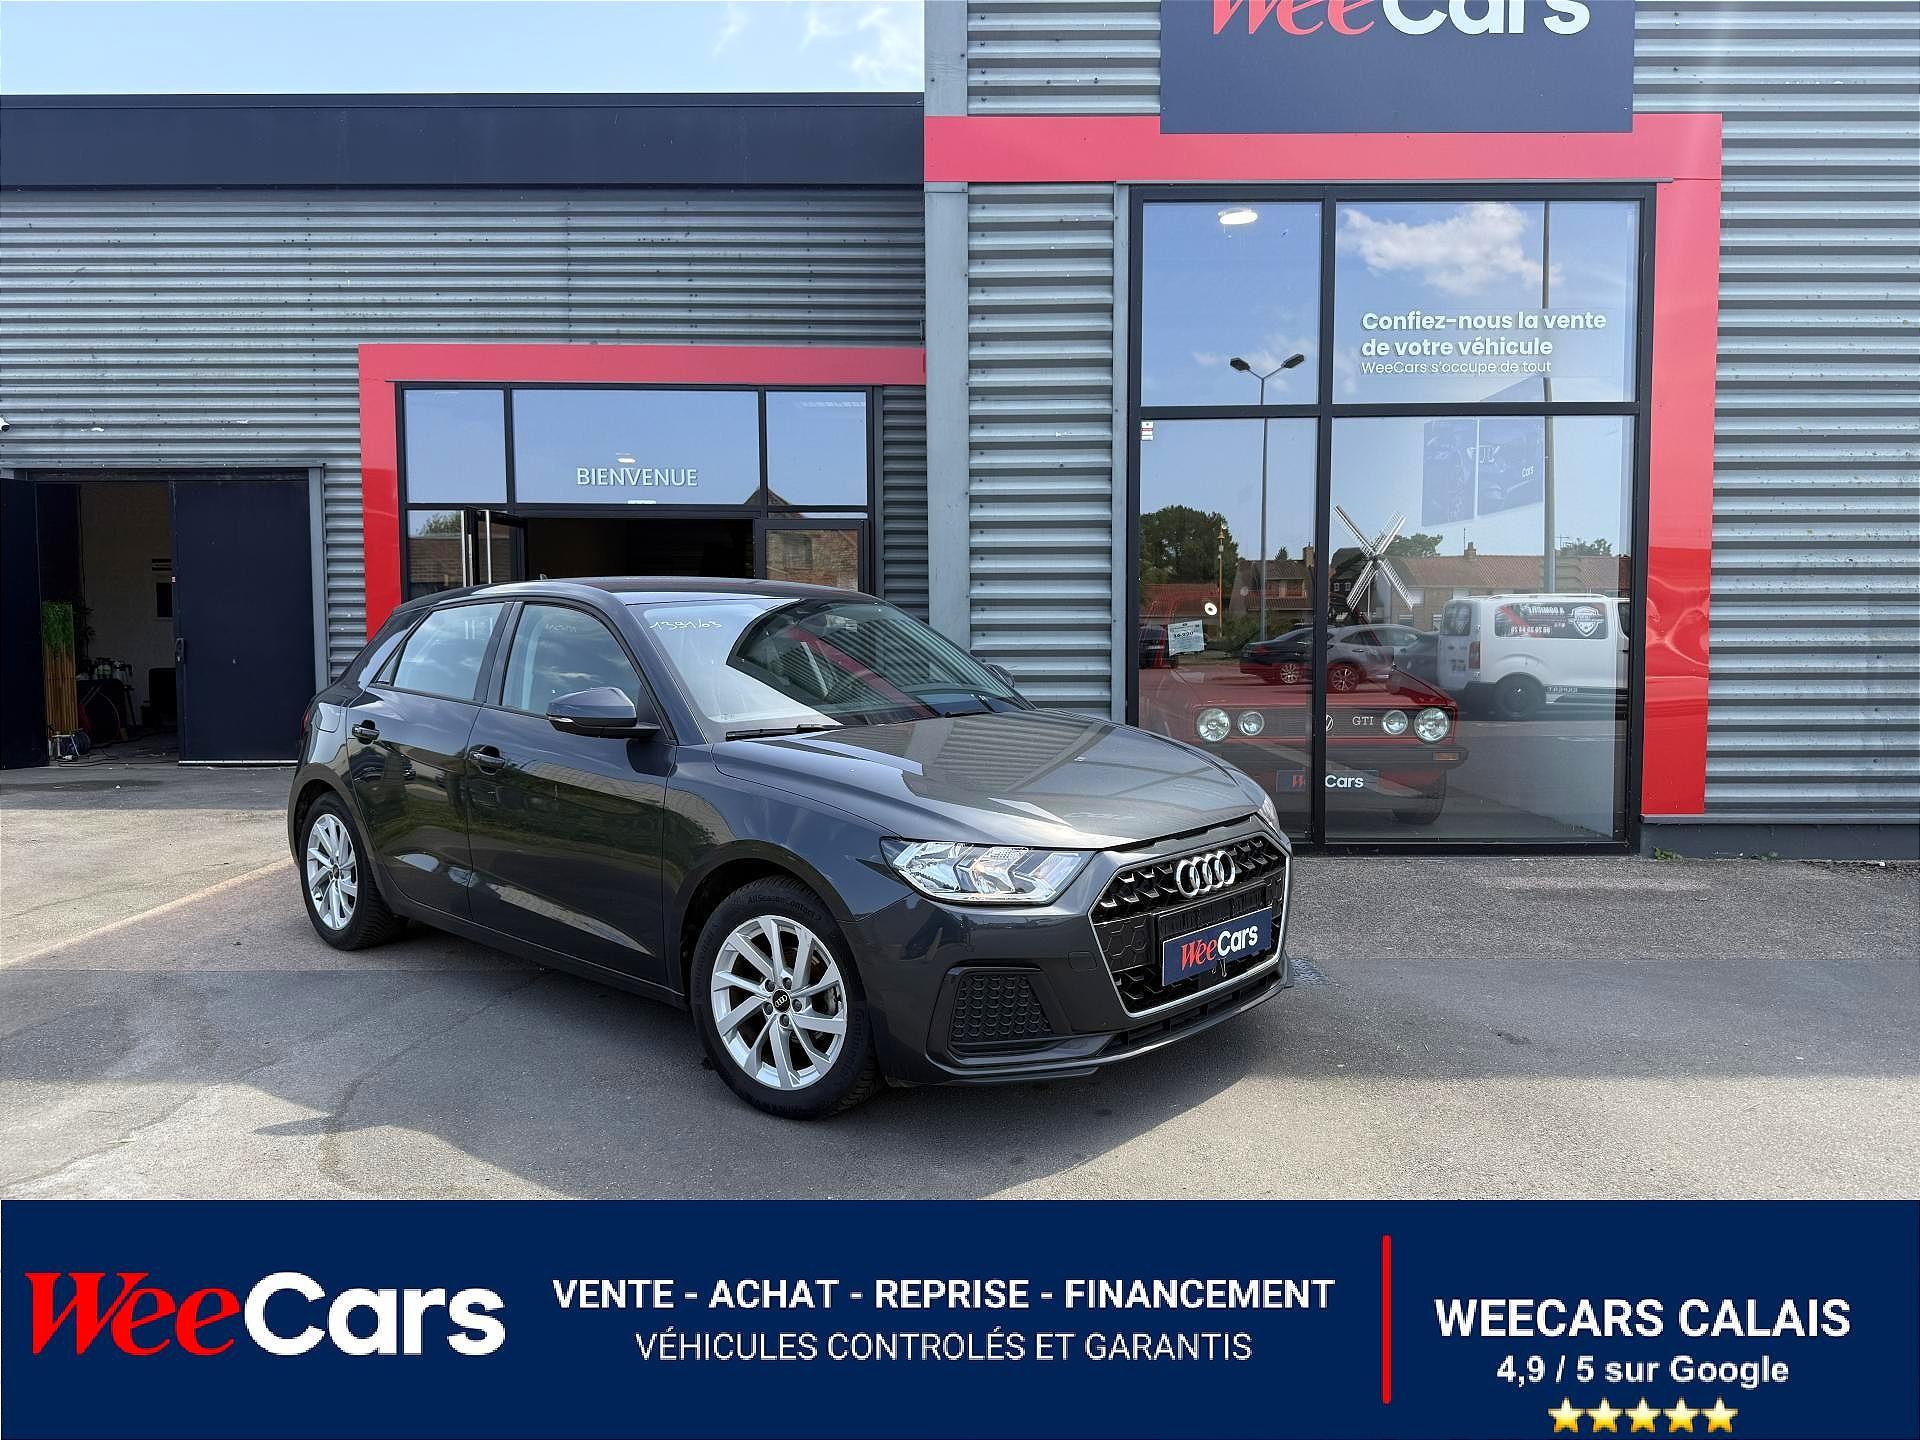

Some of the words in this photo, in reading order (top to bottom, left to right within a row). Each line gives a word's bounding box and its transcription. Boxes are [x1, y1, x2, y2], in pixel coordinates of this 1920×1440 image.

[1361, 311, 1514, 330] Confiez-nous
[1518, 312, 1539, 329] la
[1544, 313, 1607, 329] vente
[1361, 339, 1391, 356] de
[1395, 339, 1454, 356] votre
[1458, 336, 1553, 356] véhicule
[1361, 361, 1427, 374] WeeCars
[1431, 361, 1497, 376] s'occupe
[1501, 361, 1519, 374] de
[1523, 361, 1552, 374] tout
[576, 467, 699, 486] BIENVENUE
[1352, 716, 1374, 726] GTI
[1181, 925, 1259, 971] WeeCars
